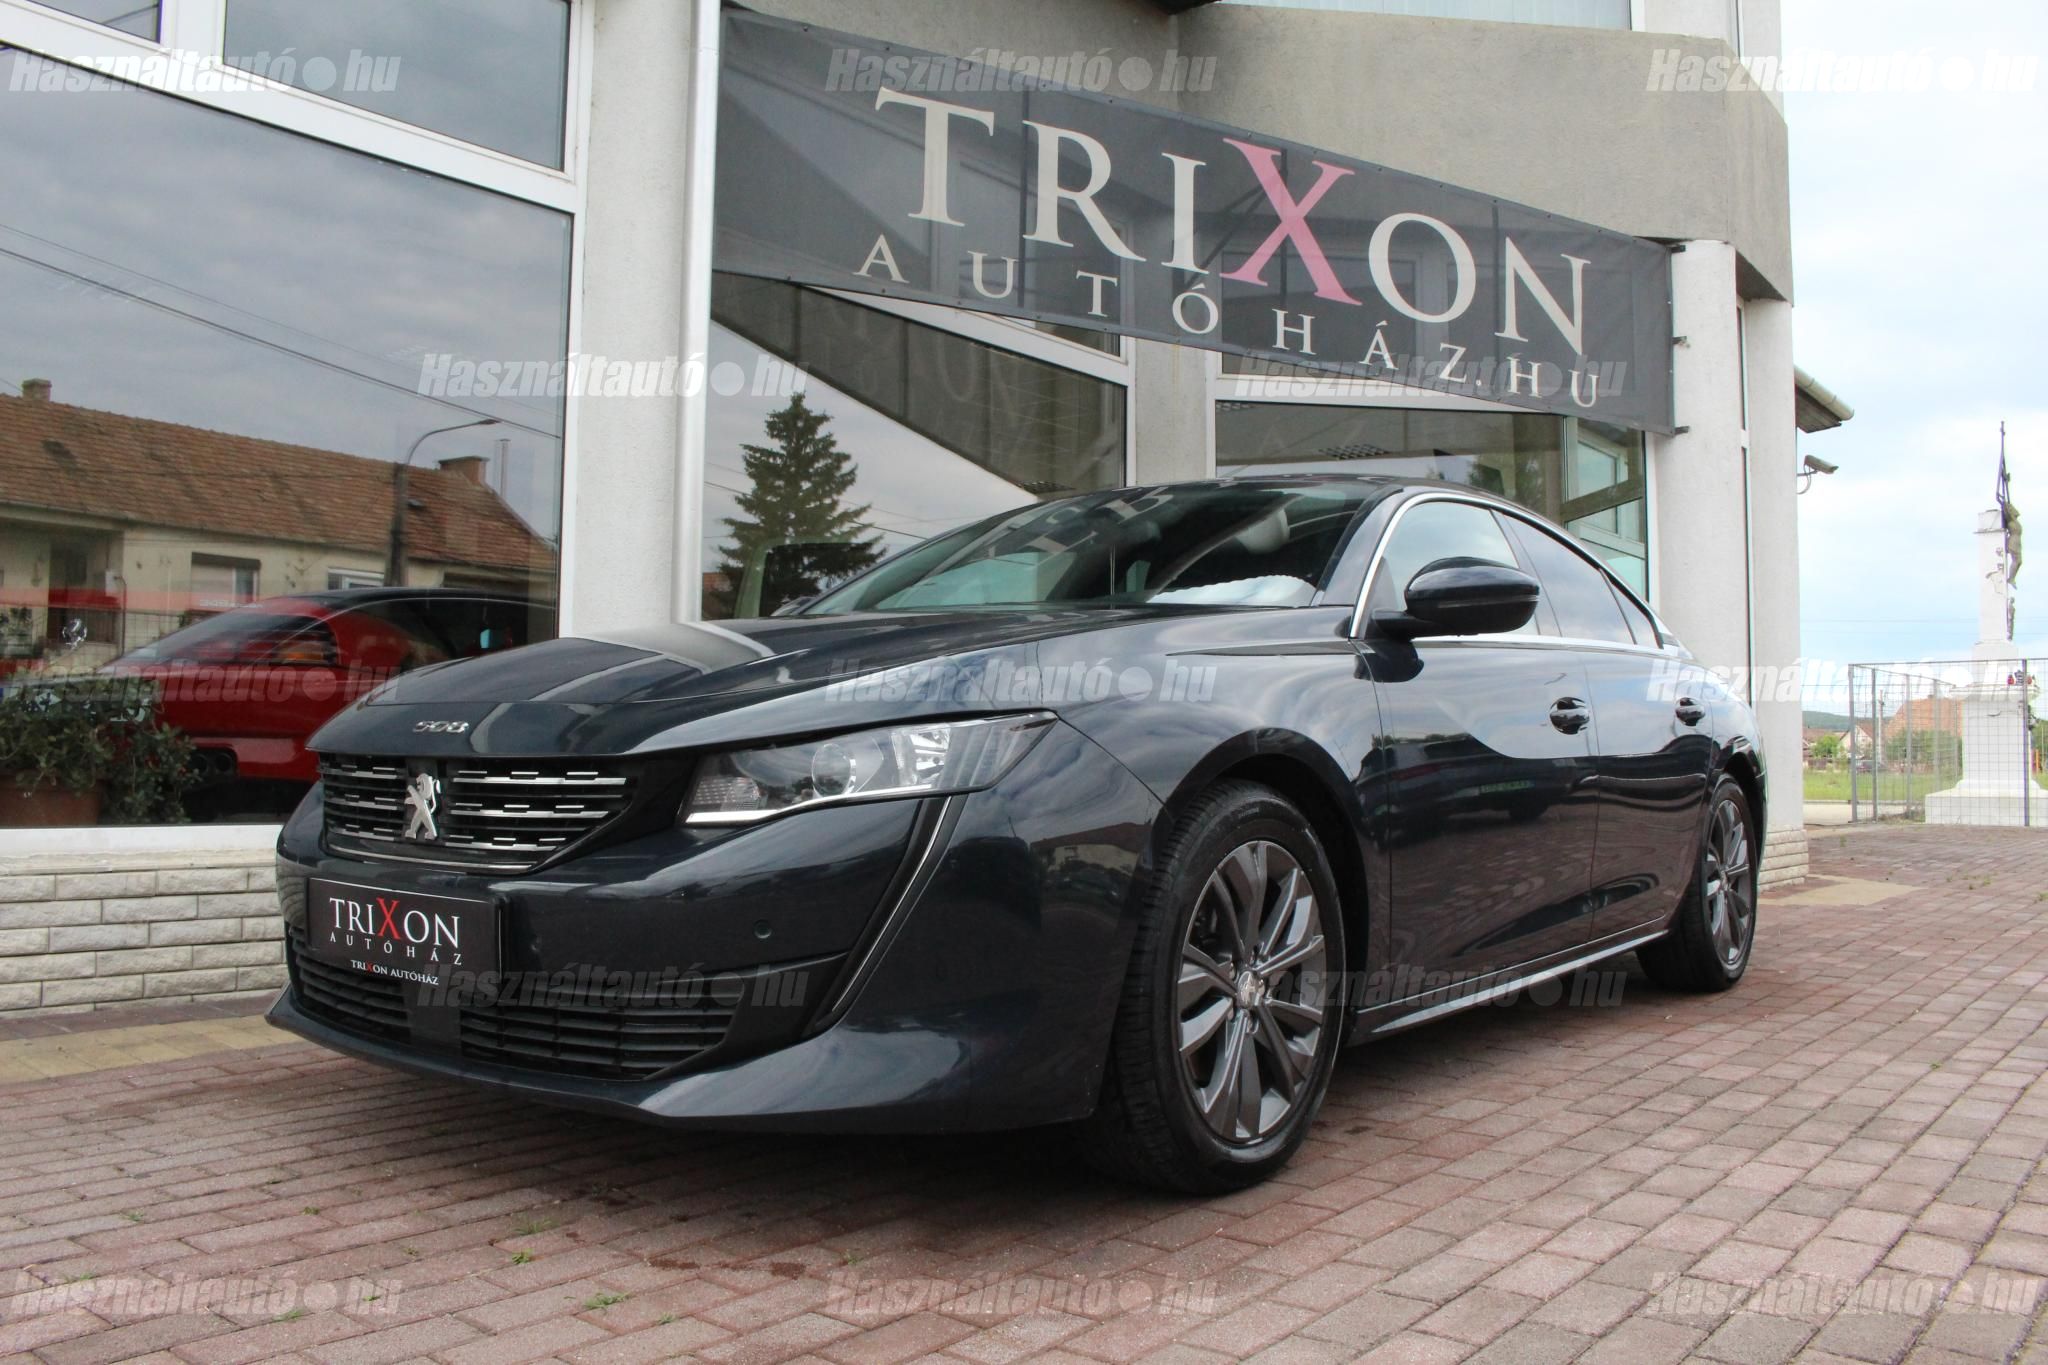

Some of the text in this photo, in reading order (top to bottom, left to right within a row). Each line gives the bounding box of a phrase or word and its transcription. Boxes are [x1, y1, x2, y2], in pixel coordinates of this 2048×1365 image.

[875, 88, 1592, 356] TRIXON
[329, 897, 460, 948] TRIXON
[330, 931, 461, 966] AUTÓHÁZ
[350, 959, 439, 986] TRIXON AUTÓHÁZ
